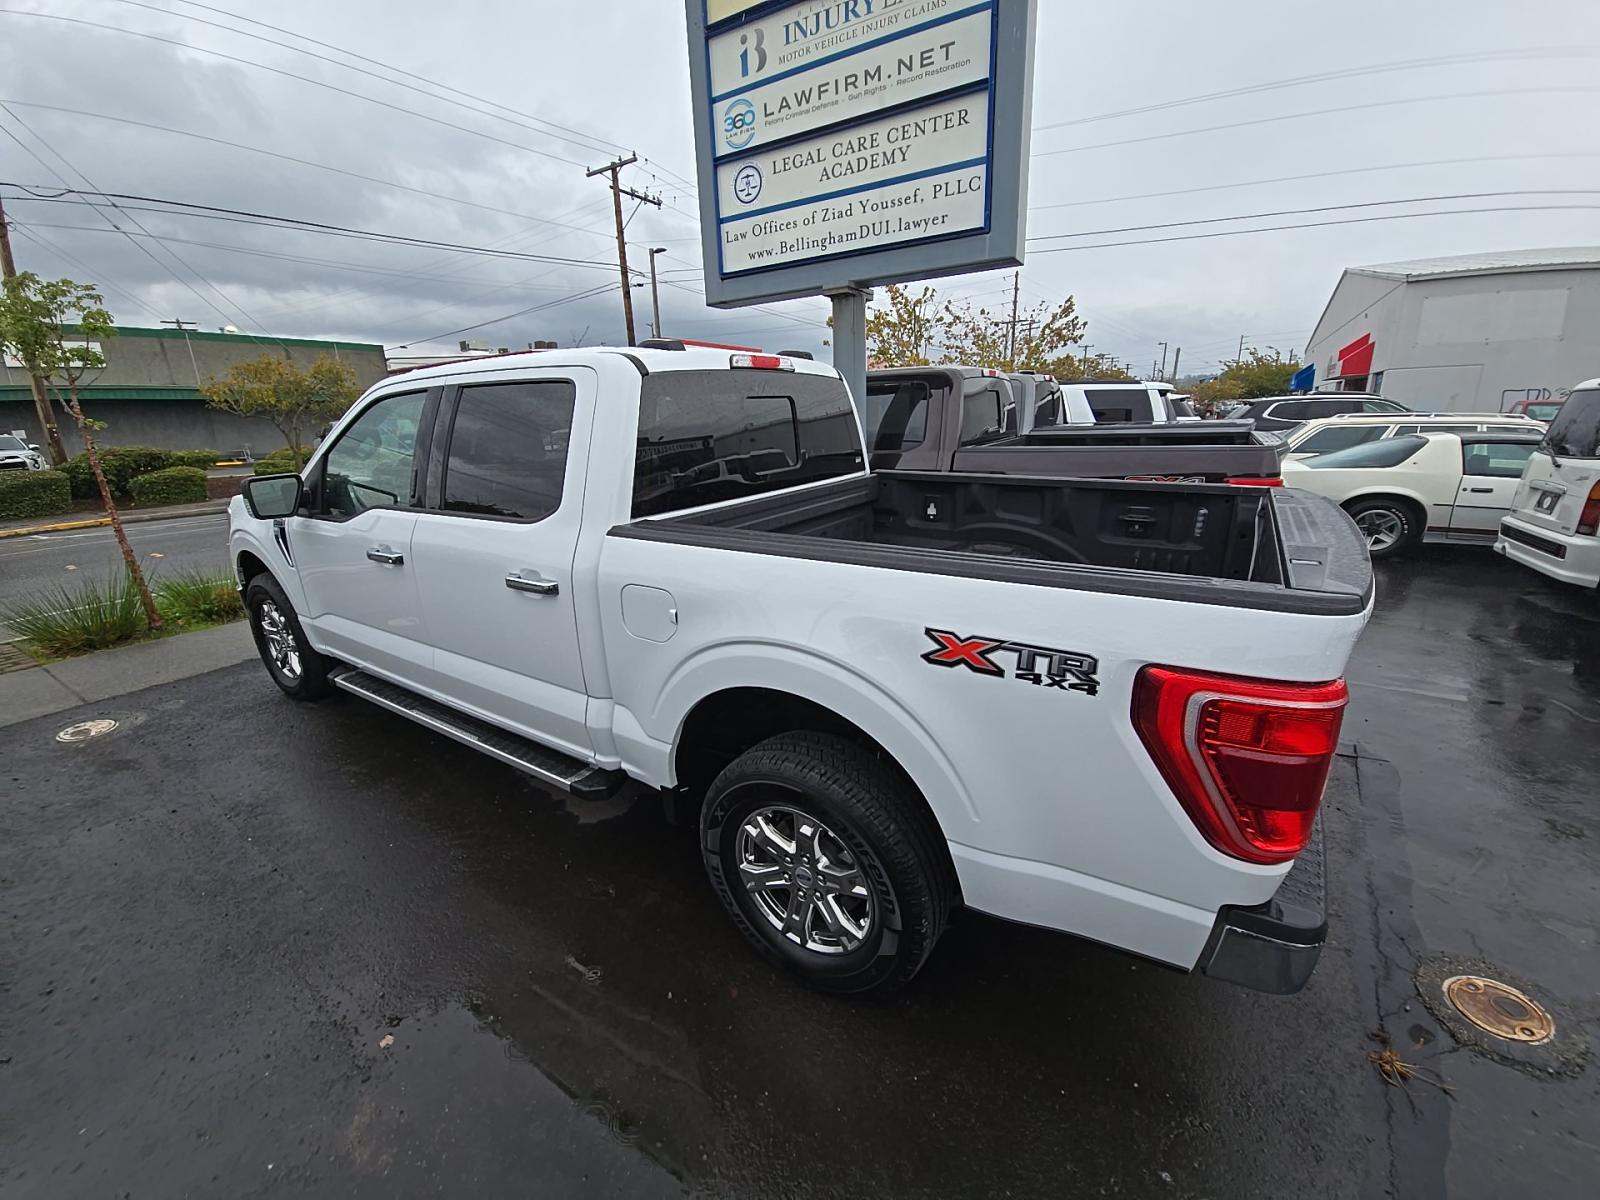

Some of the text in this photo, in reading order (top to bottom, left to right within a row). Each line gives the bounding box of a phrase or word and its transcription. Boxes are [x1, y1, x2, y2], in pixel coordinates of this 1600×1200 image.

[778, 45, 811, 65] MOTOR
[814, 28, 858, 51] VEHICLE
[861, 13, 900, 35] INJURY
[904, 0, 947, 20] CLAIMS
[783, 0, 874, 46] INJURY
[763, 40, 956, 118] LAWFIRM.NET
[764, 58, 971, 128] Felony Criminal Defense Gun Rights Record Restoration
[724, 110, 755, 132] 360
[725, 126, 755, 140] LAW FIRM
[772, 108, 970, 175] LEGAL CARE CENTER
[819, 144, 912, 182] ACADEMY
[725, 175, 982, 244] Law Offices of Ziad Youssef, PLLC
[748, 213, 948, 260] www.BellinghamDUI.lawyer
[920, 626, 1100, 685] XTR
